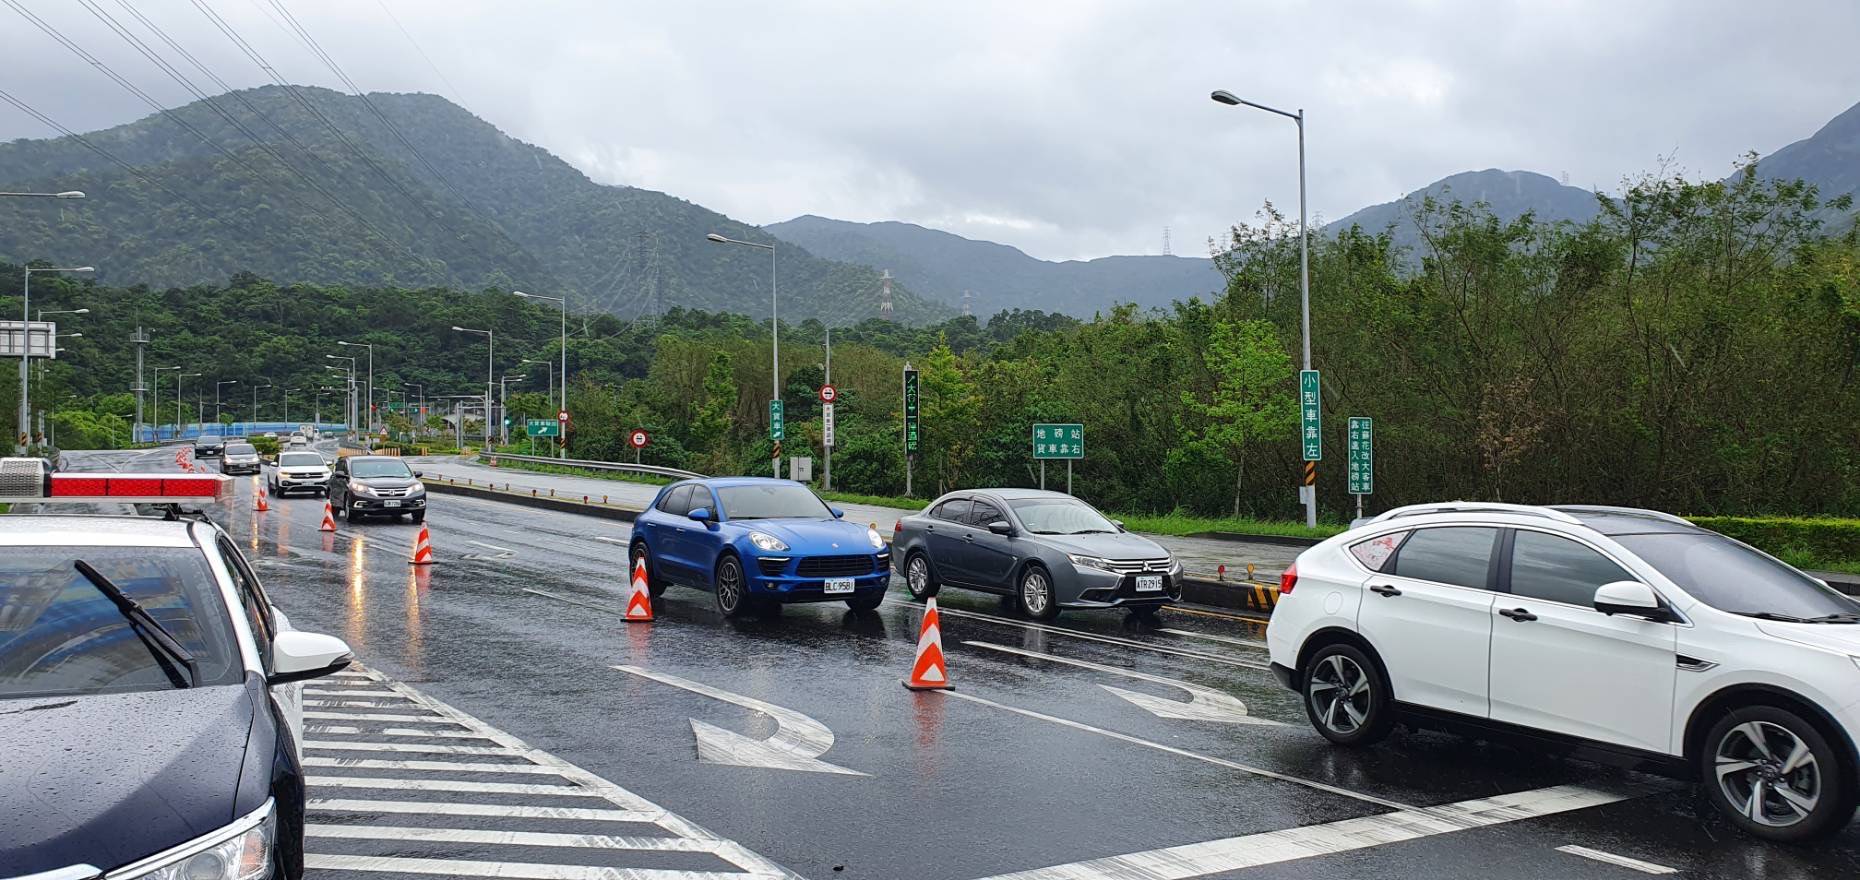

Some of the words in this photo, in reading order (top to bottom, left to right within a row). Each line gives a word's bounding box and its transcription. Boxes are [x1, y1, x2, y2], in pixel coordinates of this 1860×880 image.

[772, 402, 781, 430] 大貨車
[1304, 374, 1318, 457] 小型車靠左
[1037, 443, 1080, 454] 貨車靠右
